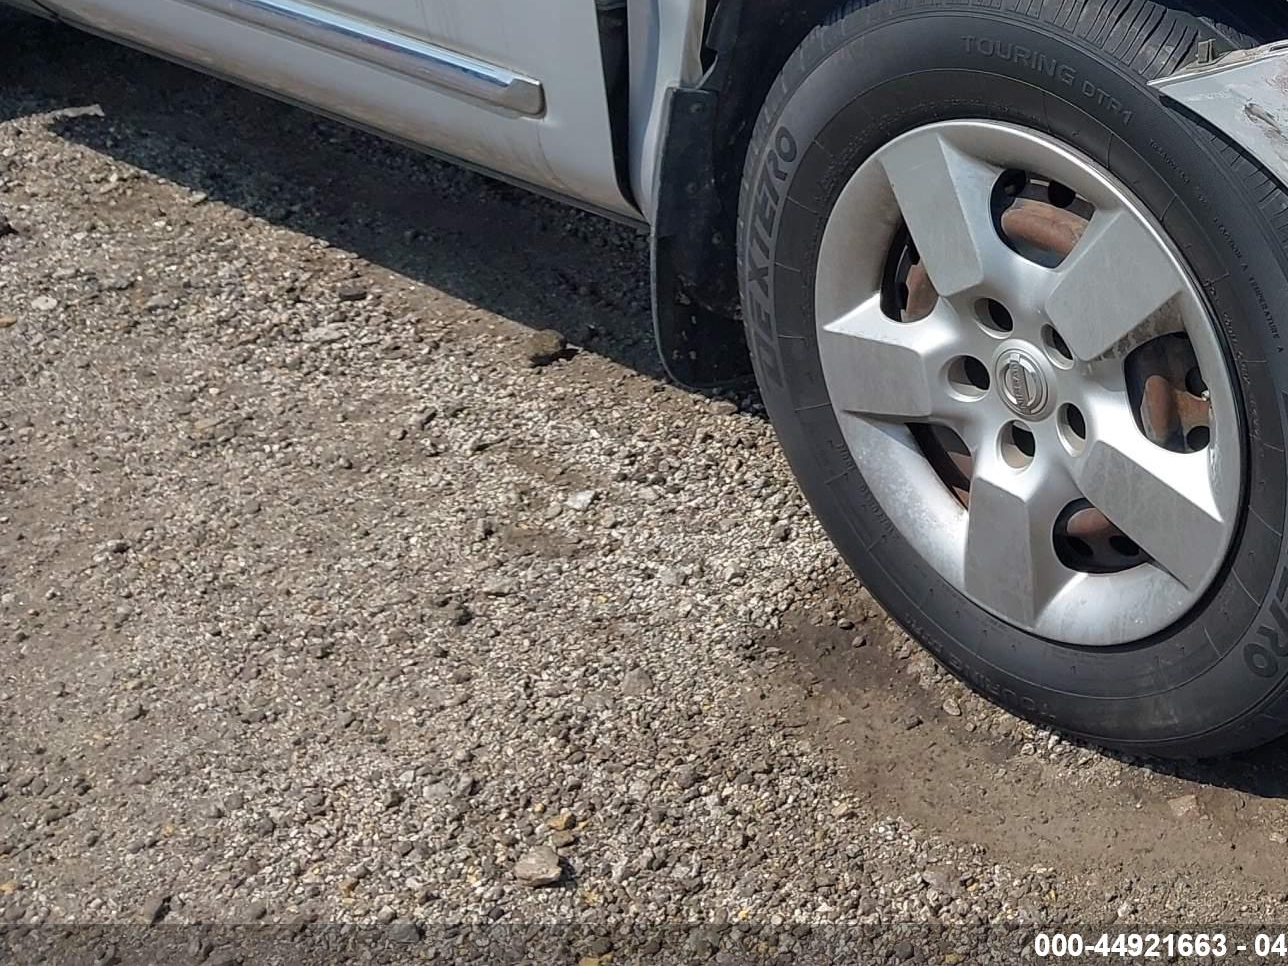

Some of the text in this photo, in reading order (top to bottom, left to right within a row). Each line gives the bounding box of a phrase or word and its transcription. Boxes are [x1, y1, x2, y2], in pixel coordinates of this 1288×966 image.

[960, 35, 1135, 125] TOURING DTR1
[748, 126, 797, 389] DEXTERO
